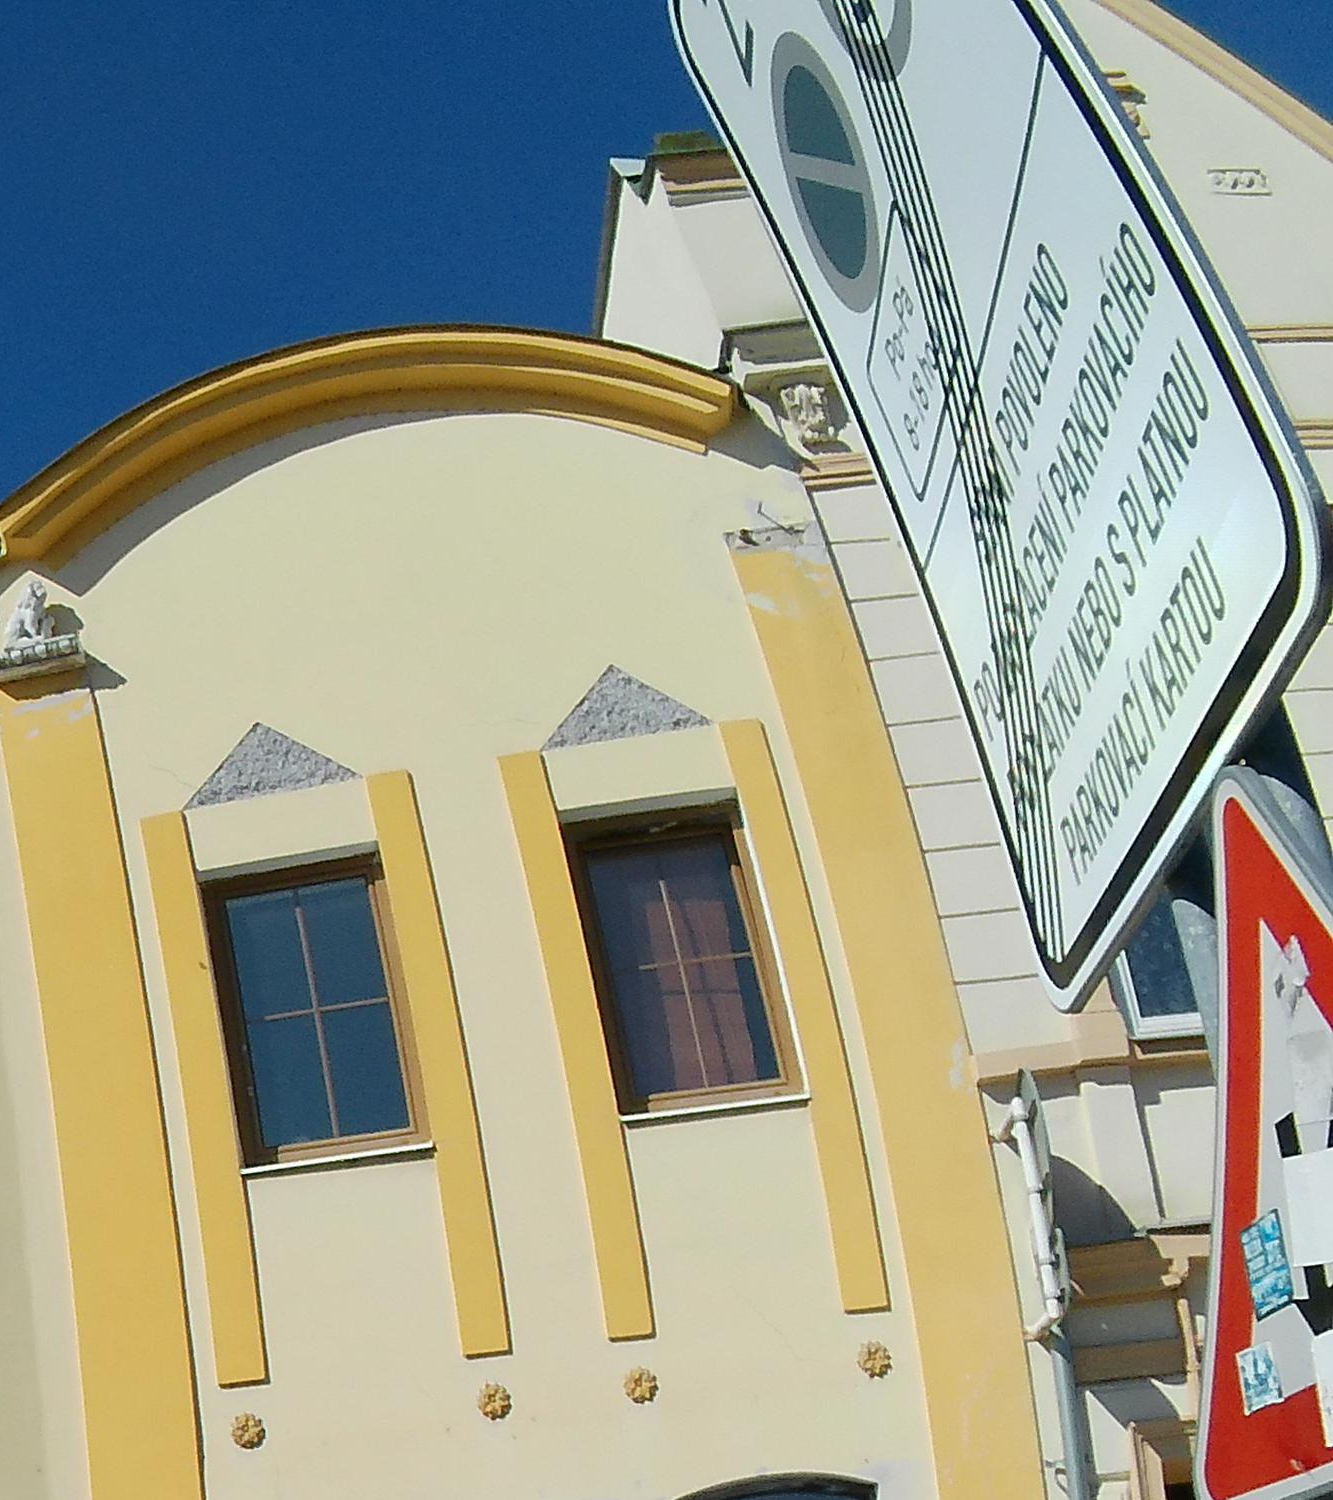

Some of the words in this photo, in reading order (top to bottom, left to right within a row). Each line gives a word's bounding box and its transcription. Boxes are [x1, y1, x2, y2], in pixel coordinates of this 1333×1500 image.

[995, 242, 1069, 476] POVOLENO
[1118, 337, 1210, 568] PLATNOU
[974, 661, 1004, 742] PO
[992, 473, 1067, 692] LACENÍ
[1047, 222, 1156, 533] PARKOVACÍHO
[1107, 523, 1136, 596] S
[1007, 645, 1081, 822] LATKU
[1060, 656, 1157, 887] PARKOVACÍ
[1139, 535, 1226, 731] KARTOU
[1067, 556, 1122, 692] NEBO
